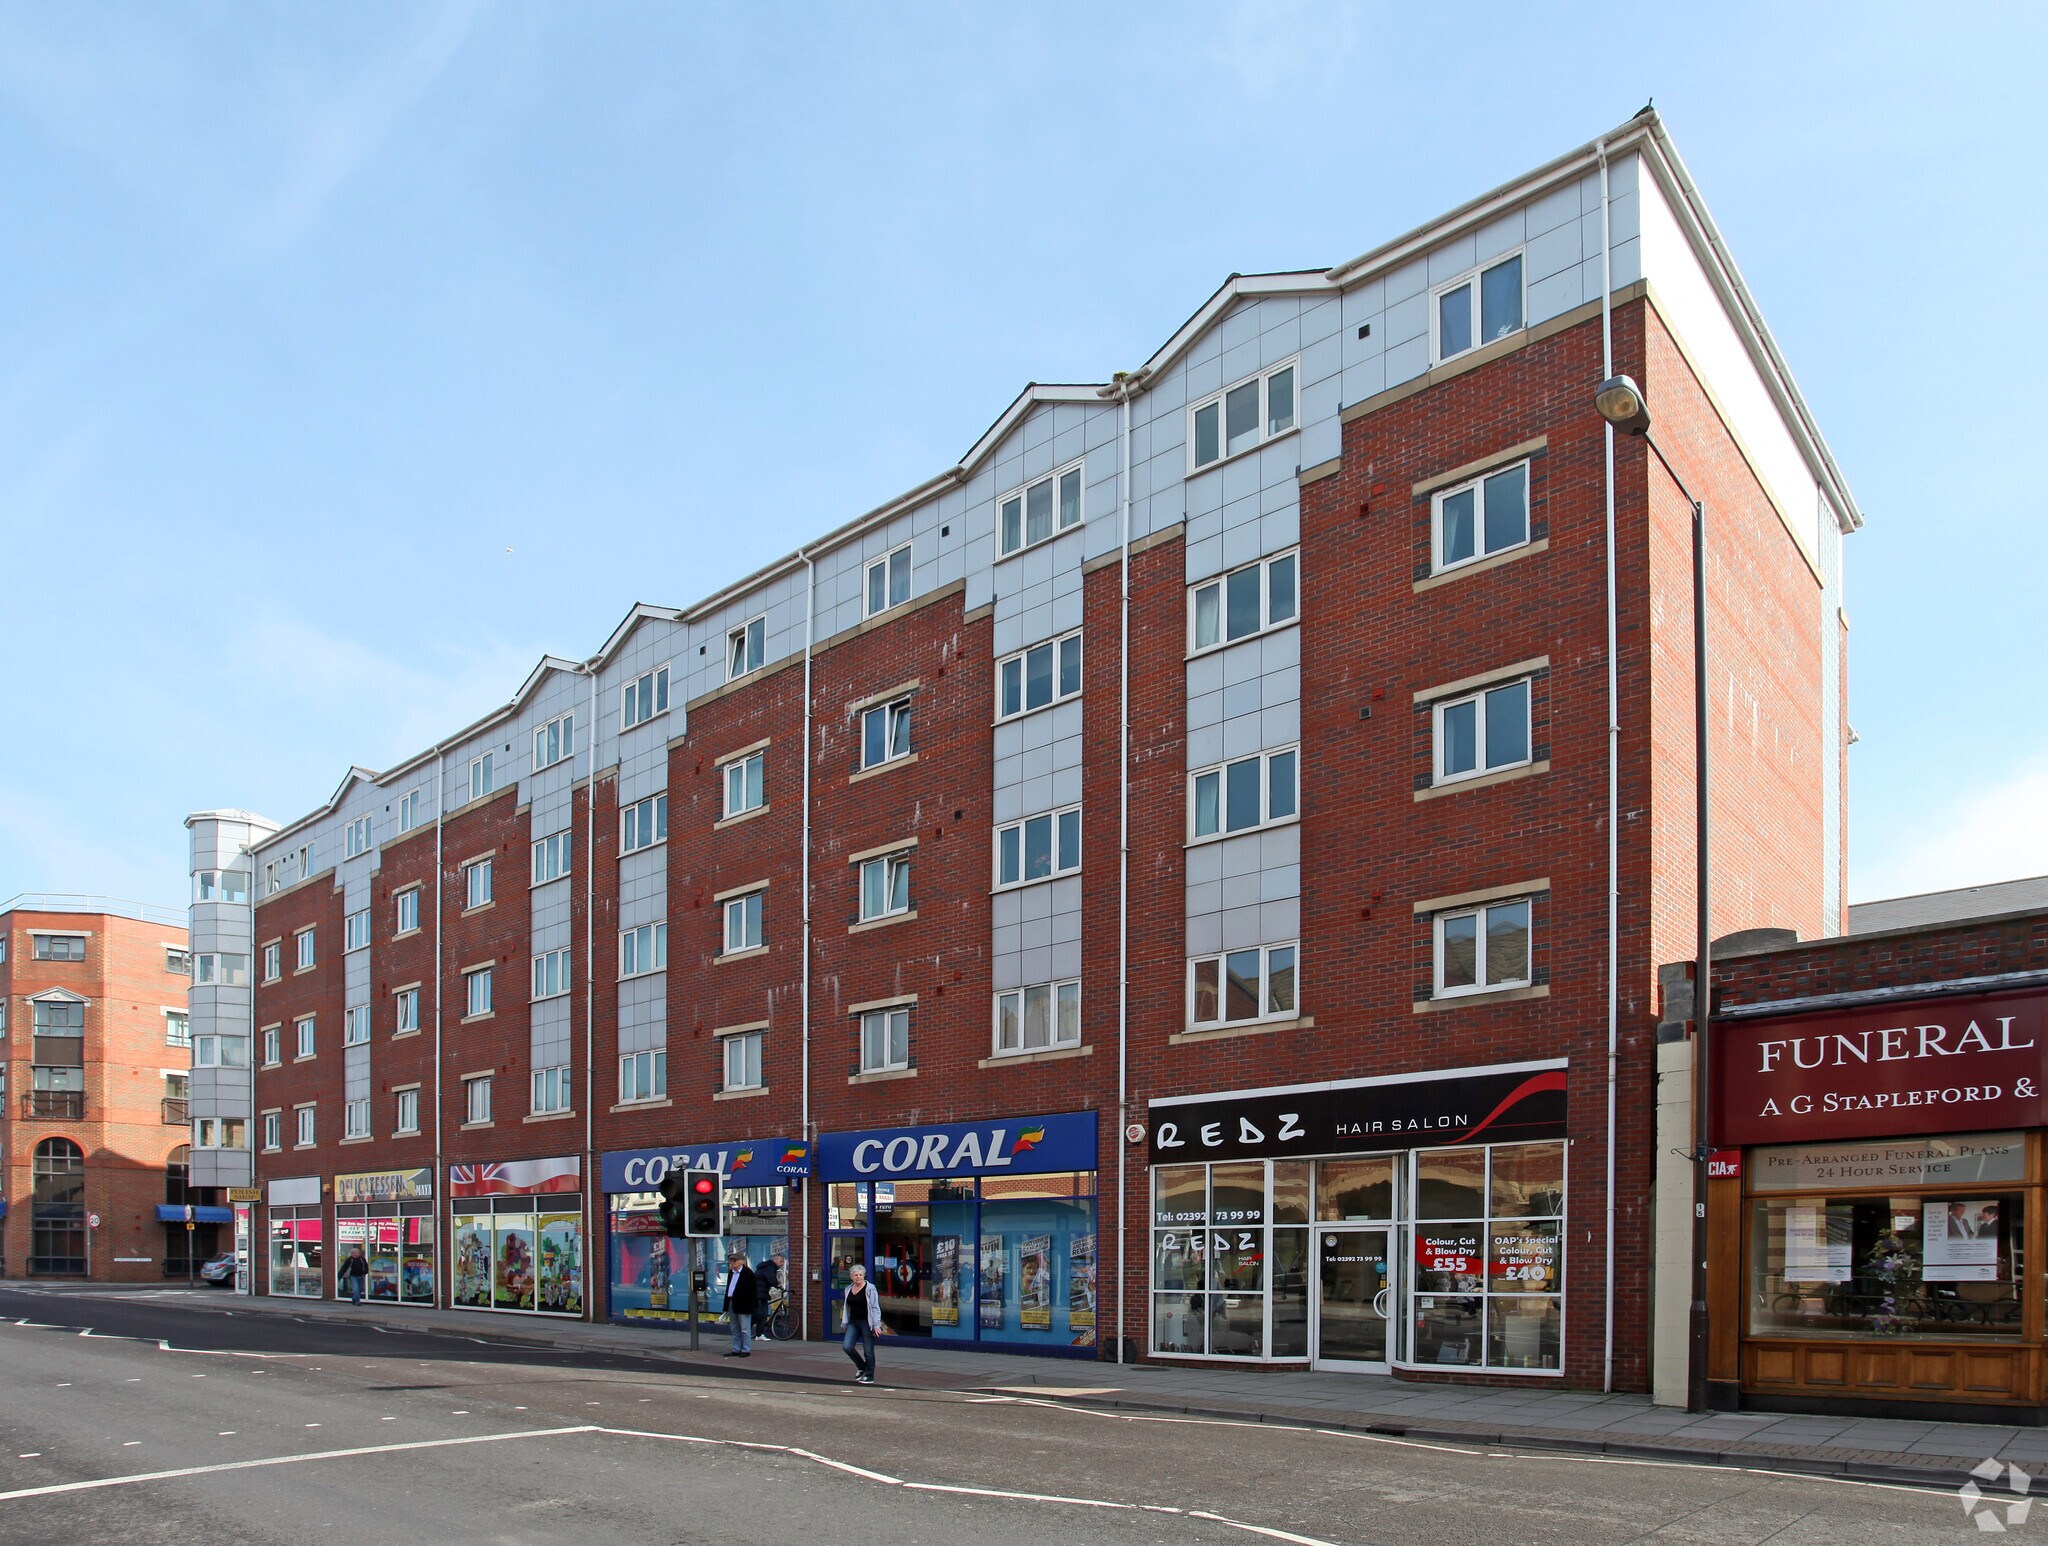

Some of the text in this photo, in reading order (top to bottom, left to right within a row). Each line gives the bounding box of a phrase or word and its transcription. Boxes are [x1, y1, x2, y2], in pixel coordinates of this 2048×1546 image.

[1758, 1016, 2034, 1073] FUNERAL
[1758, 1077, 2039, 1117] A G STAPLEFORD &
[1157, 1113, 1306, 1150] REDZ
[1336, 1114, 1468, 1135] HAIR SALON
[852, 1129, 1012, 1174] CORAL
[1768, 1145, 2010, 1167] PRE-ARRANGED FUNERAL PLANS
[776, 1165, 809, 1174] CORAL
[1816, 1164, 1952, 1178] 24 HOUR SERVICE
[338, 1174, 405, 1198] DELICATESSEN
[416, 1184, 432, 1196] MAYA
[1156, 1210, 1260, 1221] Tel: 02392 73 99 99
[936, 1239, 955, 1254] £10
[1425, 1237, 1476, 1246] Colour, Cut
[1494, 1236, 1558, 1245] OAP's Special
[1458, 1247, 1476, 1256] Dry
[1500, 1246, 1553, 1254] Colour, Cut
[1433, 1257, 1467, 1272] £55
[1499, 1256, 1553, 1265] & Blow Dry
[1506, 1266, 1546, 1281] £40
